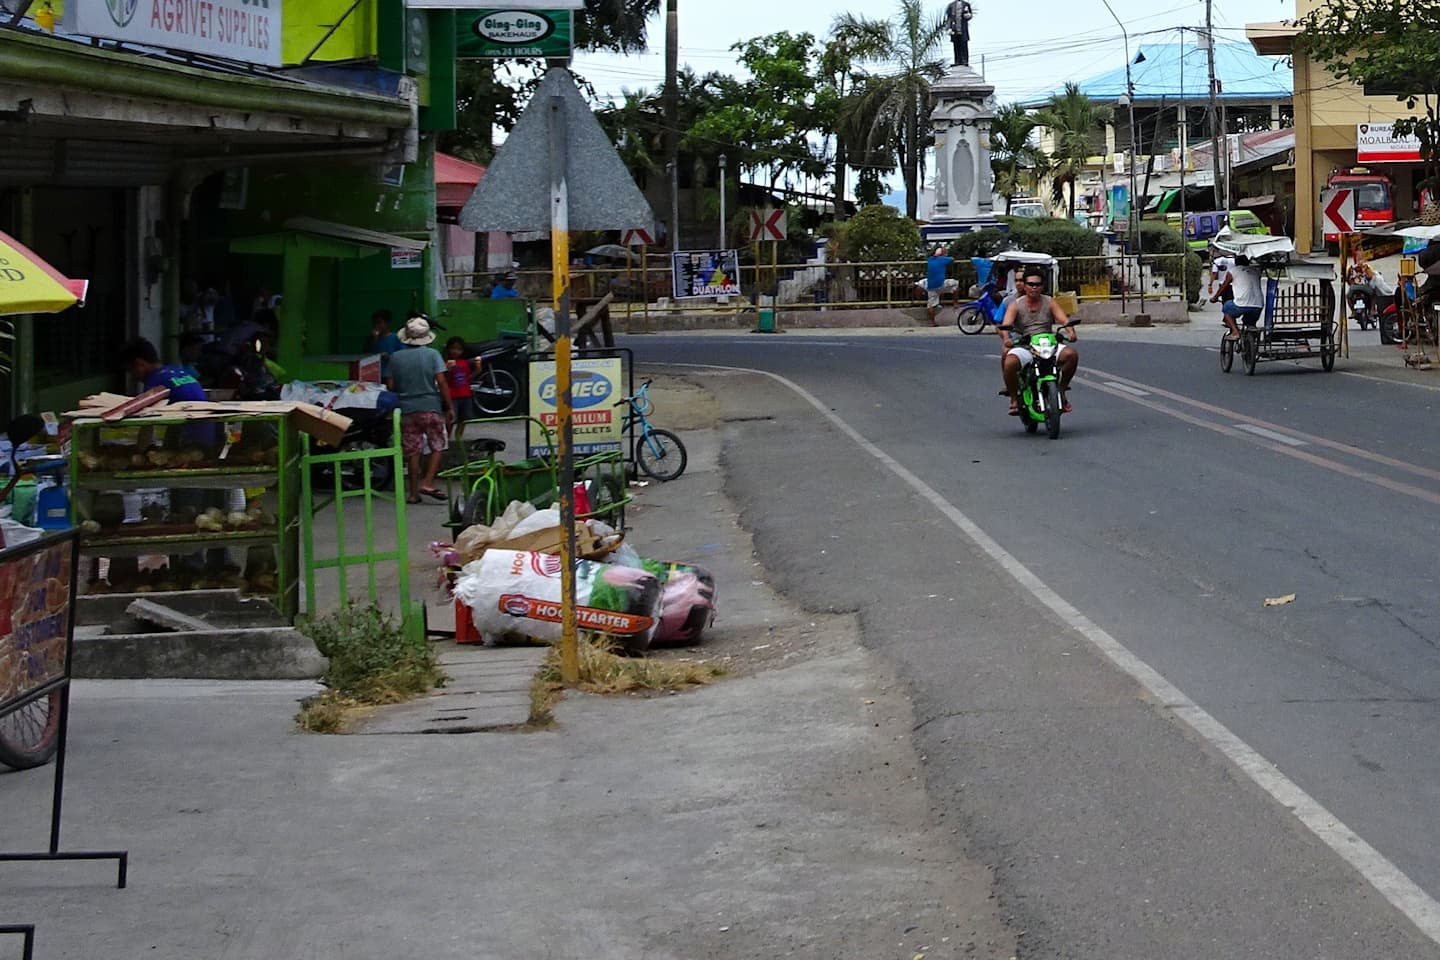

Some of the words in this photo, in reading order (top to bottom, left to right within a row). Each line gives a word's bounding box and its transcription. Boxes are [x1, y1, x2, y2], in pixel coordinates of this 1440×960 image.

[217, 6, 270, 50] SUPPLIES
[484, 19, 542, 31] Ging-Ging
[514, 47, 543, 56] HOURS
[692, 284, 738, 295] DUATHLON
[576, 611, 630, 629] STARTER
